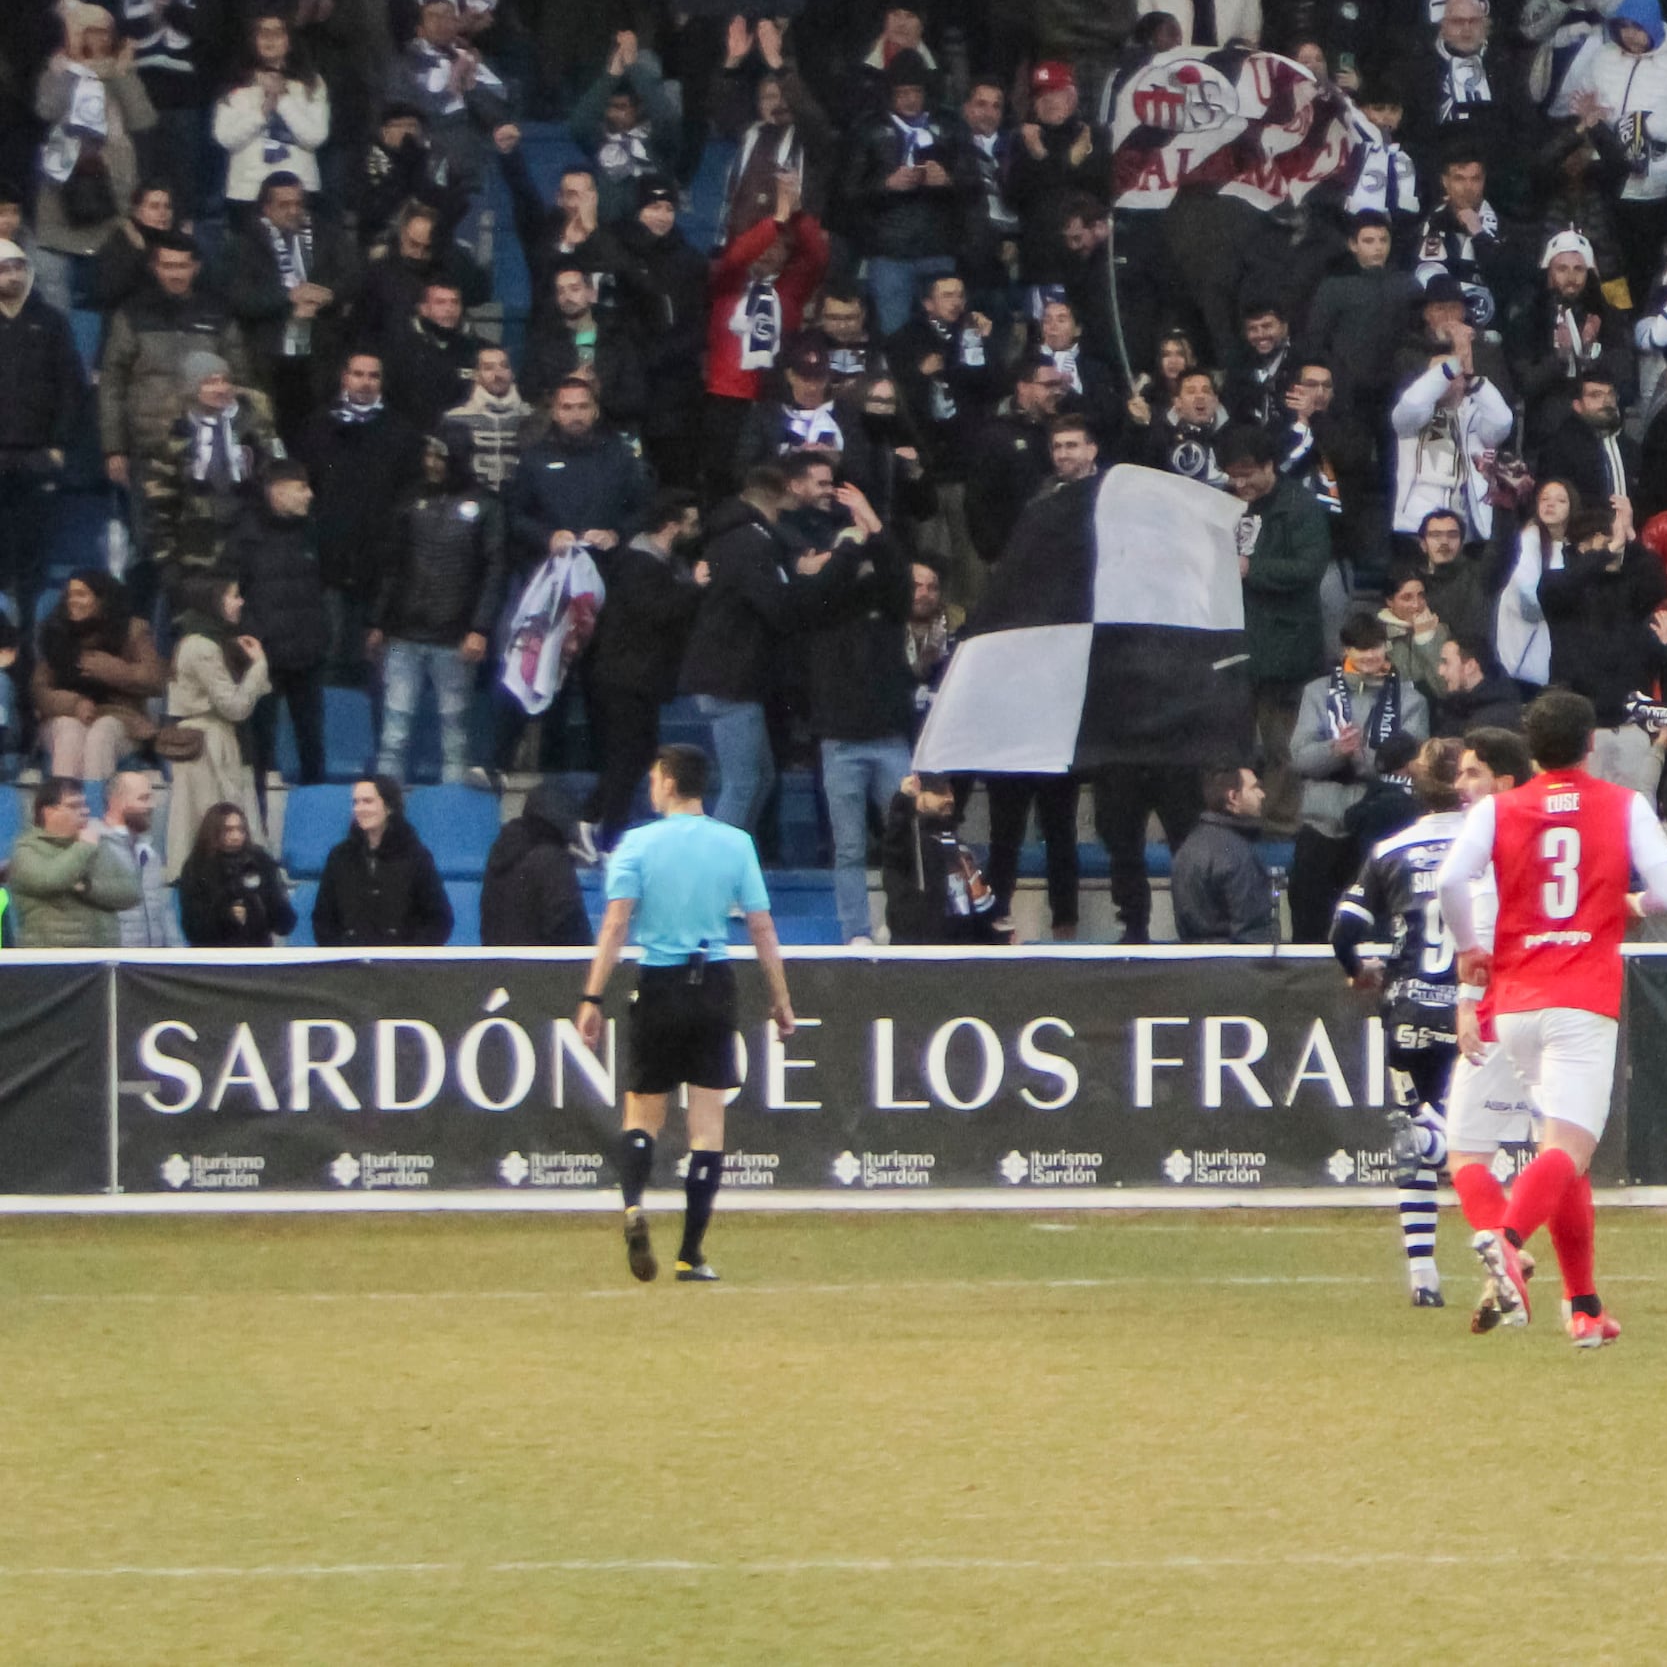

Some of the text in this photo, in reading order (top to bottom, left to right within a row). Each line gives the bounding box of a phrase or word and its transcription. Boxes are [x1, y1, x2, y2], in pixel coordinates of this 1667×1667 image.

[1542, 826, 1581, 920] 3
[1423, 899, 1456, 975] 9
[137, 986, 618, 1116] SARDÓN
[873, 1015, 1081, 1112] LOS
[1132, 1016, 1387, 1110] FRAI
[866, 1150, 936, 1167] turismo
[1034, 1149, 1103, 1167] turismo
[1199, 1148, 1267, 1166] turismo
[866, 1167, 930, 1184] Sardón
[1034, 1166, 1097, 1184] Sardón
[1199, 1165, 1260, 1183] Sardón
